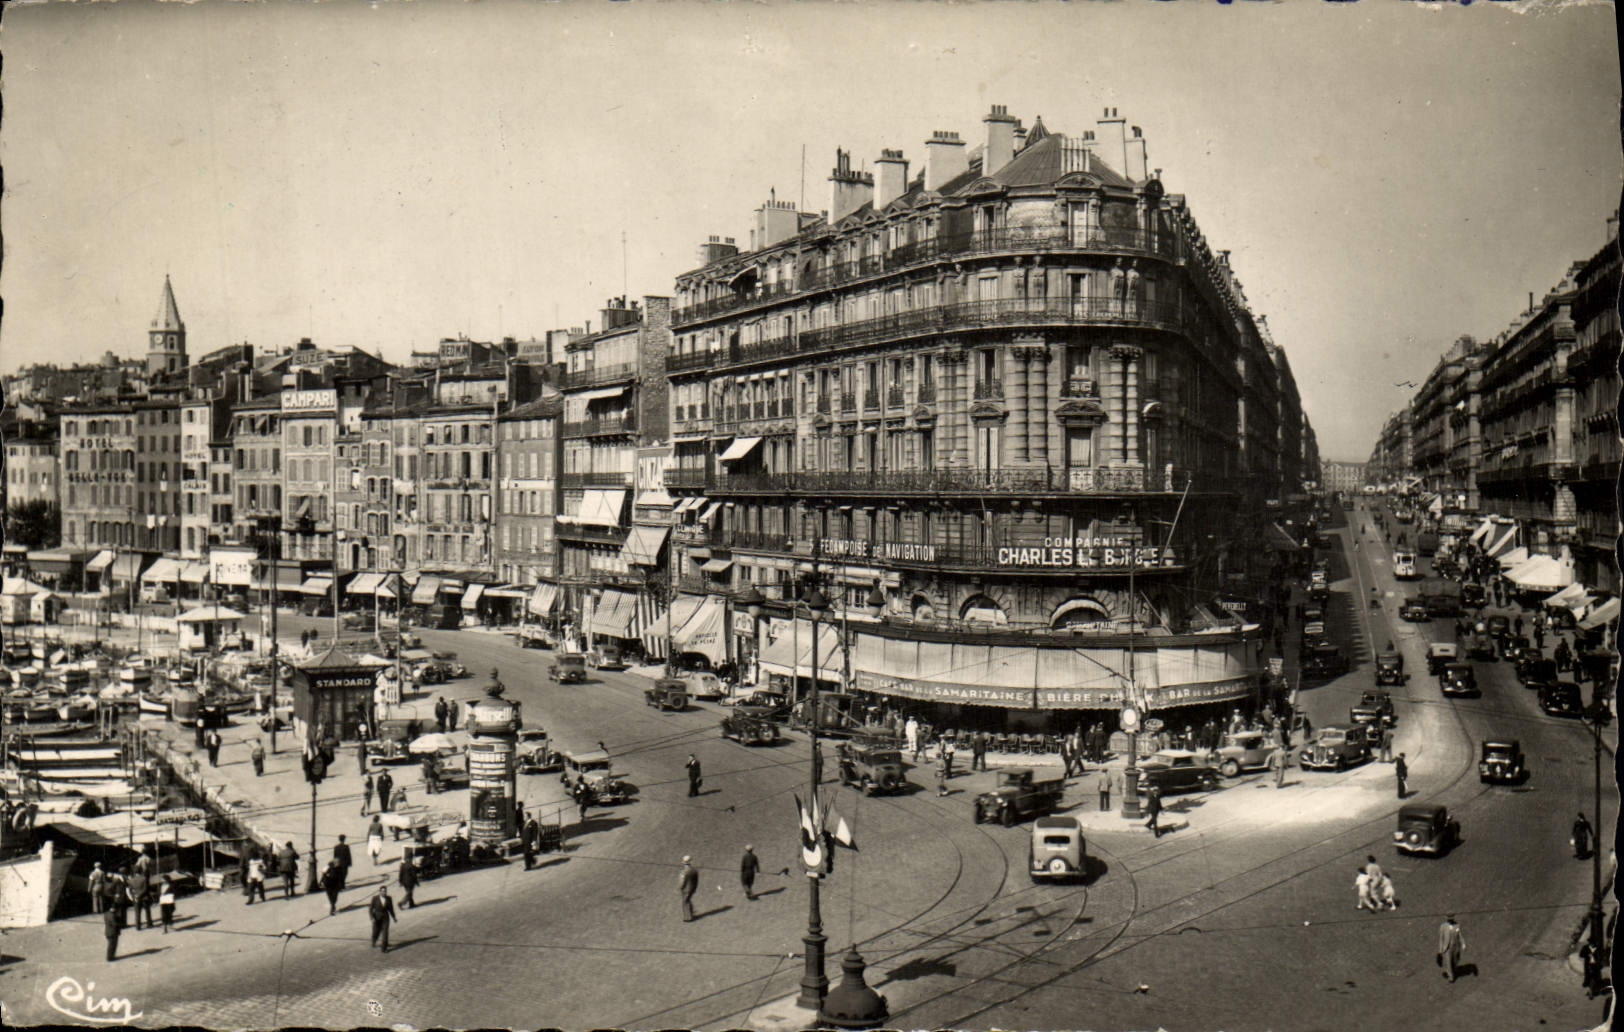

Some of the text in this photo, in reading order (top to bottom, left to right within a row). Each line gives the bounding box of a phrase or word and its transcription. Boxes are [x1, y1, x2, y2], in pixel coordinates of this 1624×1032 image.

[284, 392, 335, 408] CAMPARI
[80, 437, 113, 448] HOTEL
[886, 543, 935, 561] NAVIGATION
[998, 547, 1073, 566] CHARLES
[316, 678, 371, 688] STANDARD
[935, 687, 1024, 701] SAMARITAINE
[1169, 688, 1190, 699] BAR
